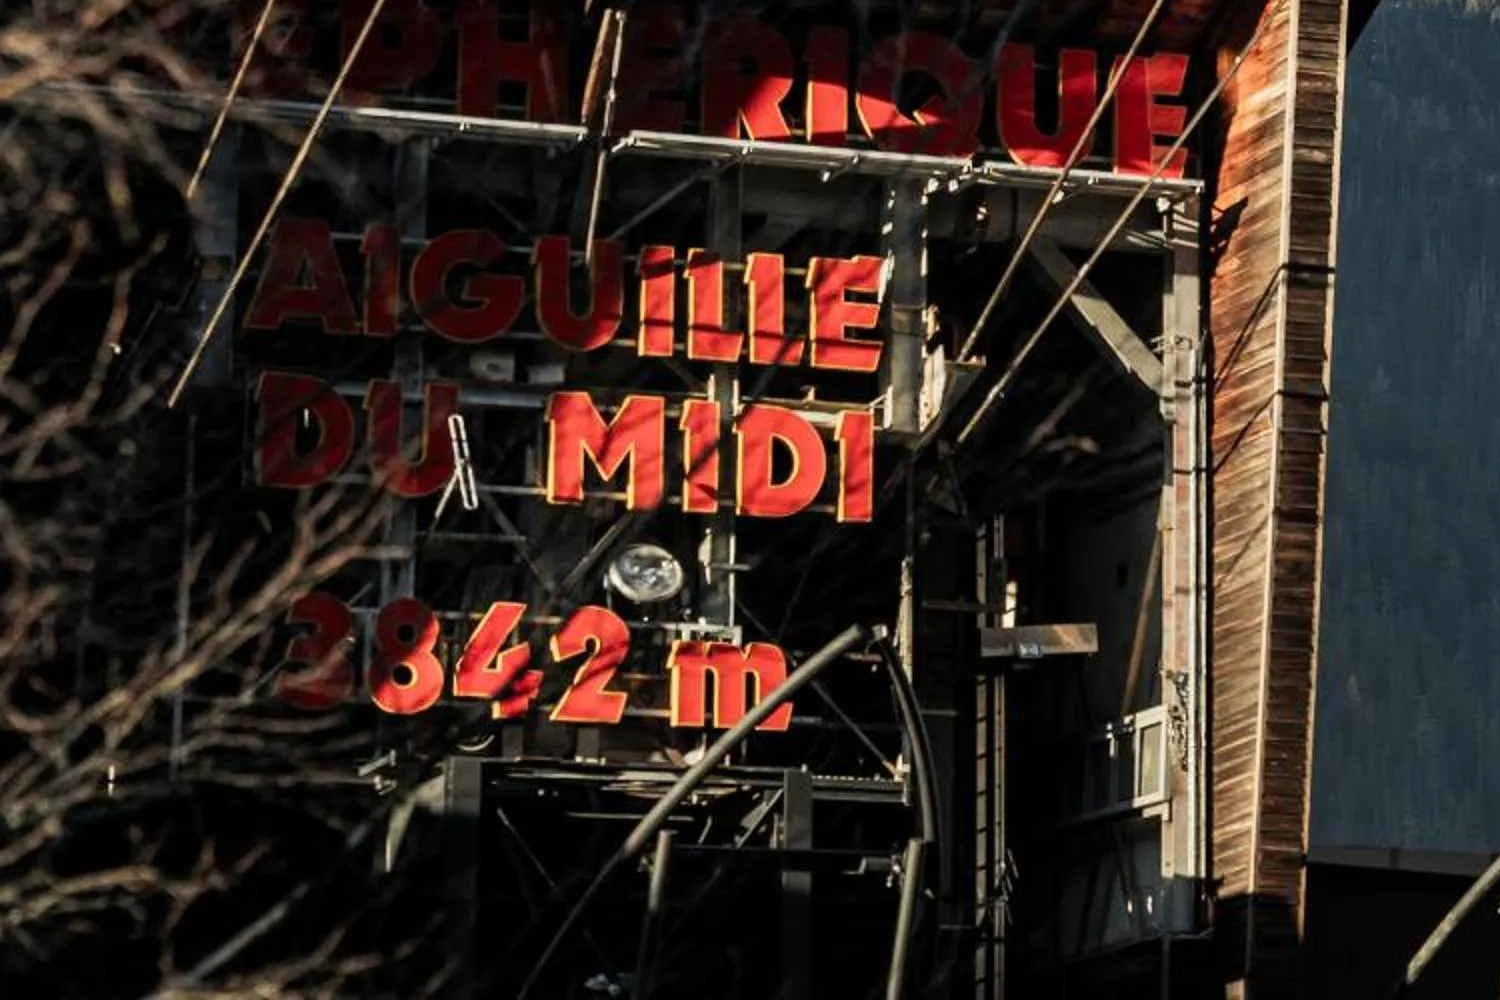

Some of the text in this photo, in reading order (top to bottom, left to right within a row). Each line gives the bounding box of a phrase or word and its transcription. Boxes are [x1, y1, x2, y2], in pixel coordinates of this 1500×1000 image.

[243, 217, 886, 372] AIGUILLE
[254, 368, 876, 524] DU MIDI
[275, 591, 796, 733] 3842 m
